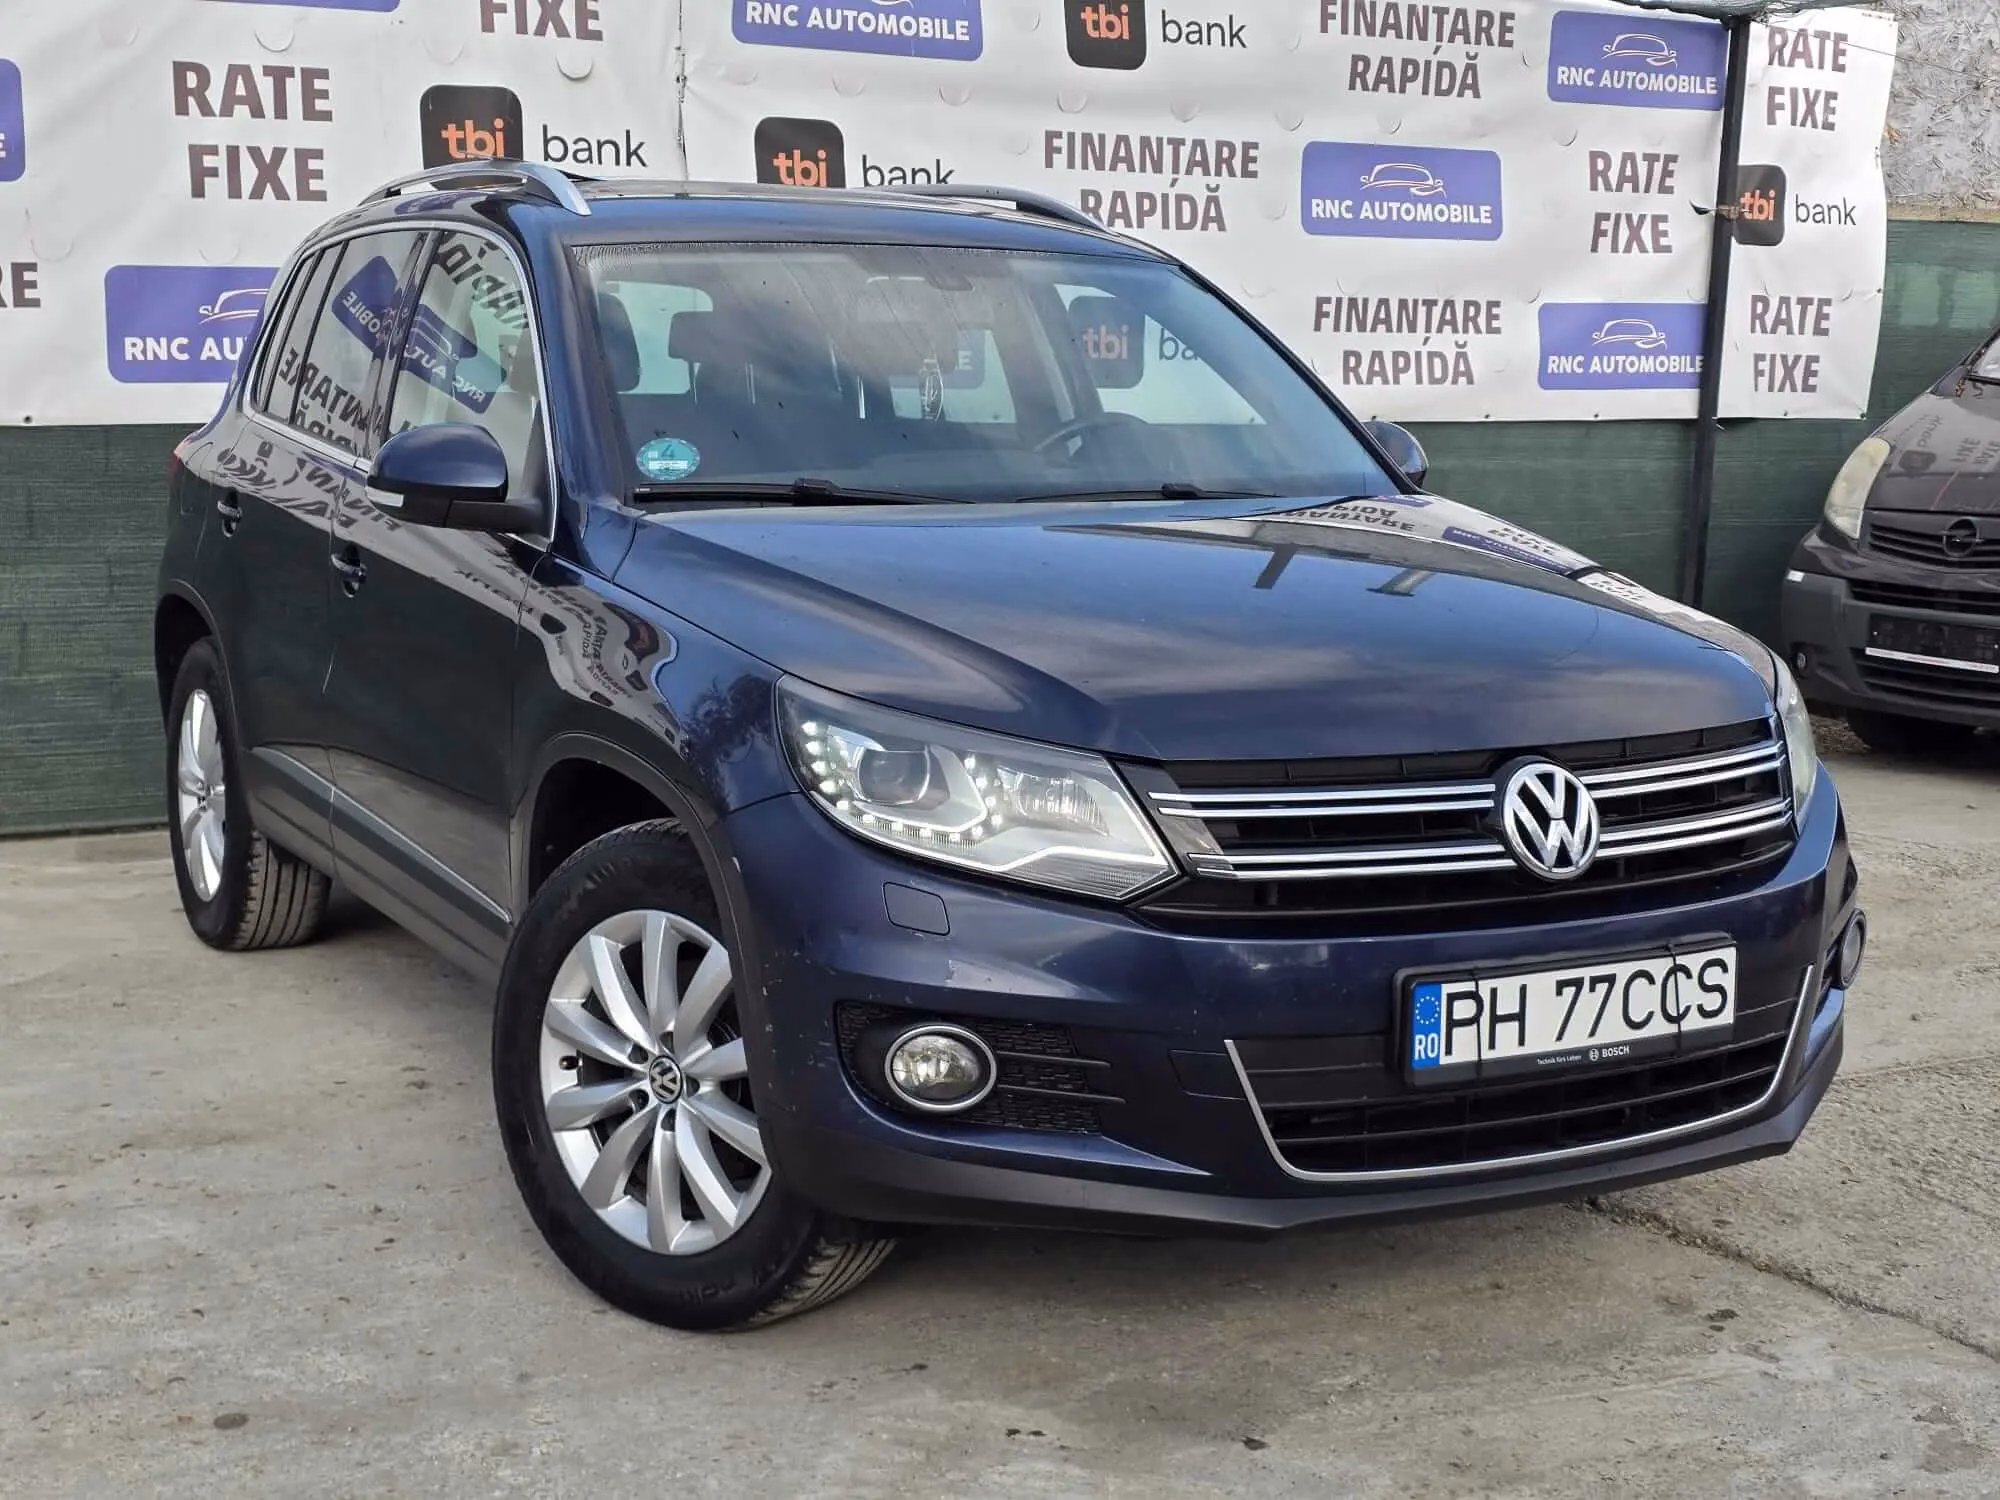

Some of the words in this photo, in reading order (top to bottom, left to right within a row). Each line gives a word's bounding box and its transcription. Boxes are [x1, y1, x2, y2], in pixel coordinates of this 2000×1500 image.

[479, 0, 603, 42] FIXE
[746, 1, 799, 26] RNC
[807, 7, 970, 41] AUTOMOBILE
[1081, 1, 1130, 41] tbi
[1162, 9, 1248, 48] bank
[1319, 0, 1516, 56] FINANȚARE
[1767, 25, 1848, 73] RATE
[172, 60, 333, 122] RATE
[1348, 51, 1481, 99] RAPIDĂ
[1557, 65, 1594, 87] RNC
[1599, 72, 1718, 95] AUTOMOBILE
[1766, 85, 1839, 131] FIXE
[441, 118, 504, 160] tbi
[542, 124, 648, 167] bank
[1044, 129, 1260, 188] FINANȚARE
[188, 144, 328, 202] FIXE
[772, 149, 827, 188] tbi
[862, 154, 955, 187] bank
[1588, 150, 1679, 195] RATE
[1311, 198, 1354, 219] RNC
[1360, 201, 1492, 224] AUTOMOBILE
[1741, 190, 1775, 220] tbi
[1795, 194, 1856, 226] bank
[1590, 212, 1673, 254] FIXE
[1313, 296, 1502, 346] FINANȚARE
[1751, 294, 1832, 337] RATE
[124, 336, 191, 361] RNC
[1082, 324, 1129, 360] tbi
[1342, 340, 1475, 385] RAPIDĂ
[1547, 355, 1583, 374] RNC
[1589, 354, 1704, 374] AUTOMOBILE
[1754, 353, 1820, 393] FIXE
[1445, 984, 1527, 1056] PH
[1555, 957, 1729, 1042] 77CCS
[1414, 1032, 1439, 1061] RO
[1601, 1045, 1630, 1058] BOSCH
